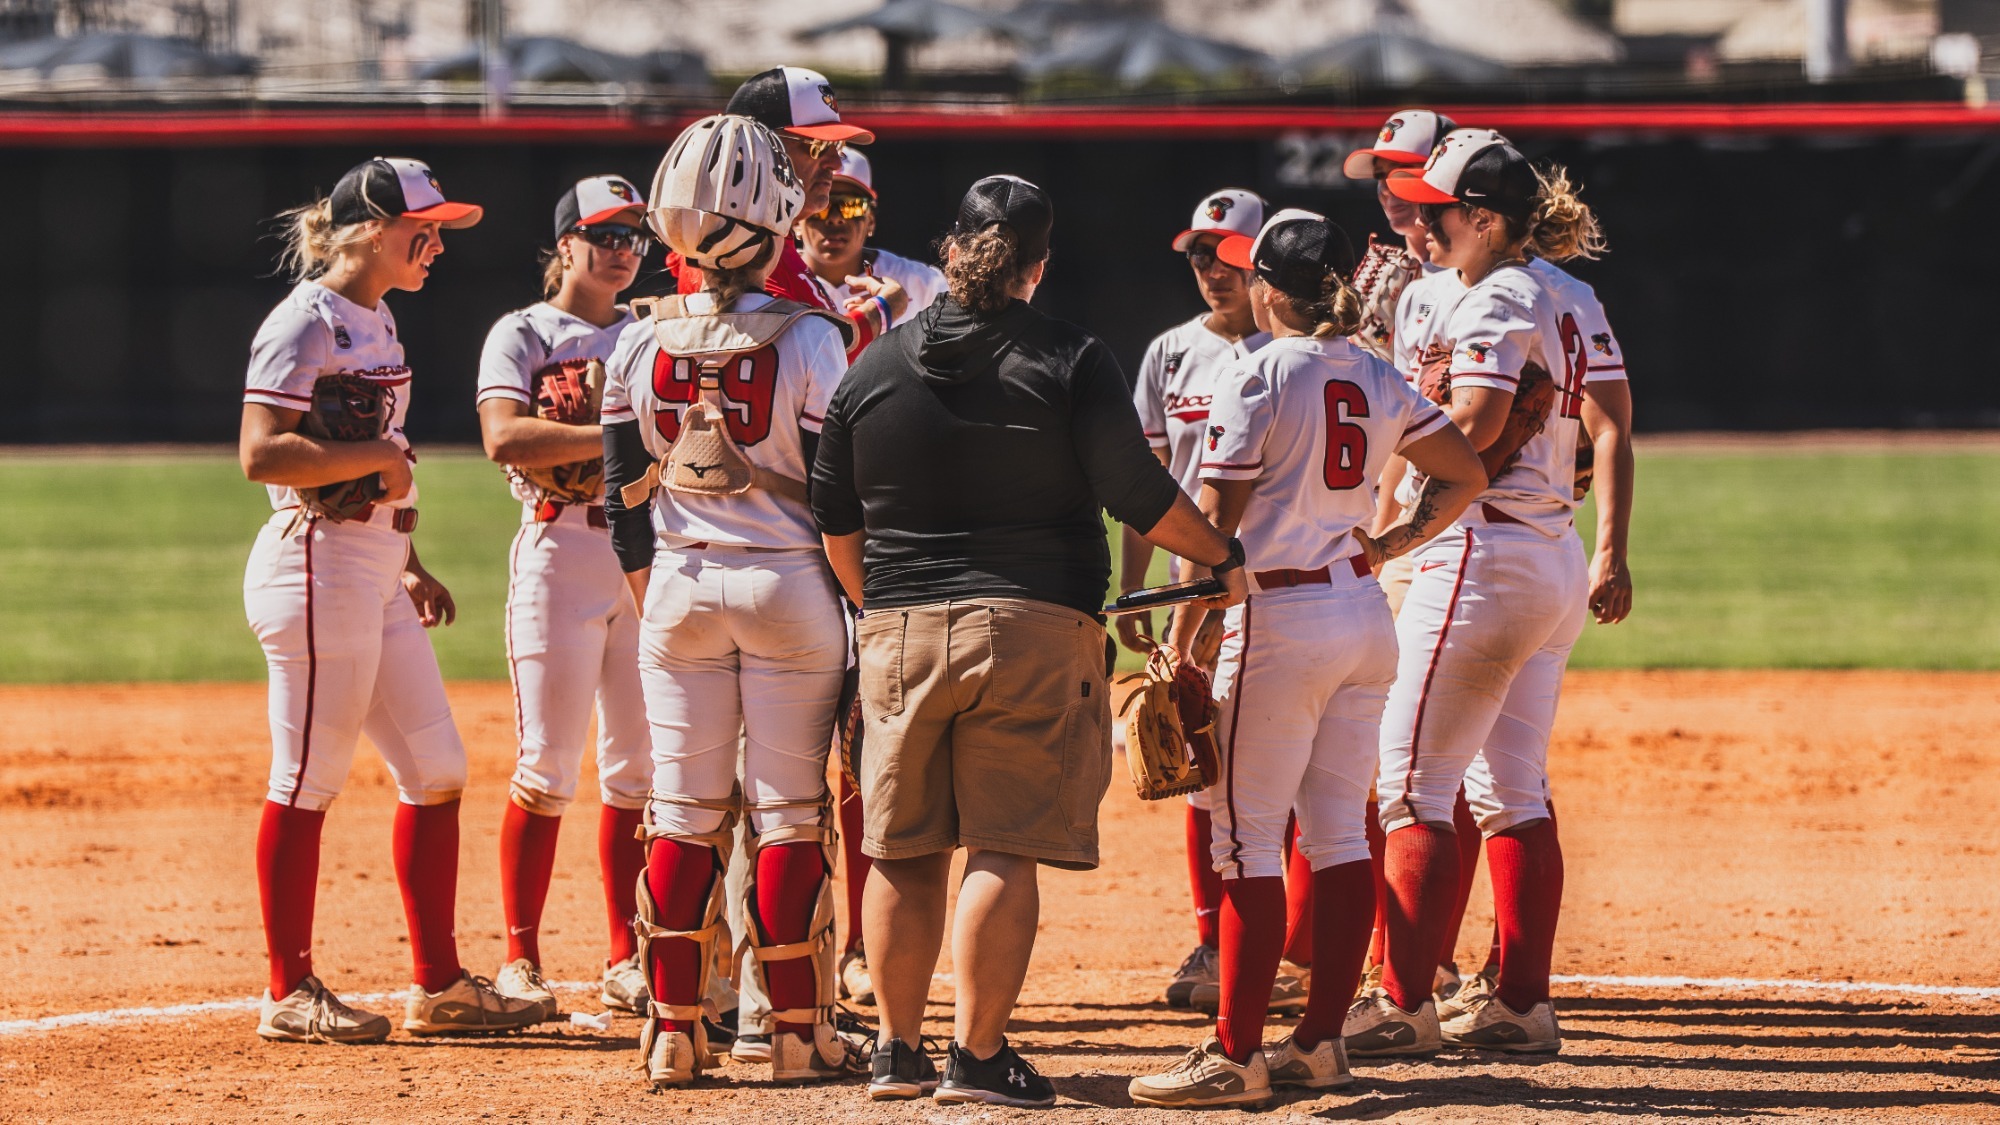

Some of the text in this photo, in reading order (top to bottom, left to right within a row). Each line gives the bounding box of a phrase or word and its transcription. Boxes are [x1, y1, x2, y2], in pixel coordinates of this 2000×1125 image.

[1275, 131, 1374, 187] 22
[651, 344, 779, 447] 99
[1323, 379, 1370, 491] 6
